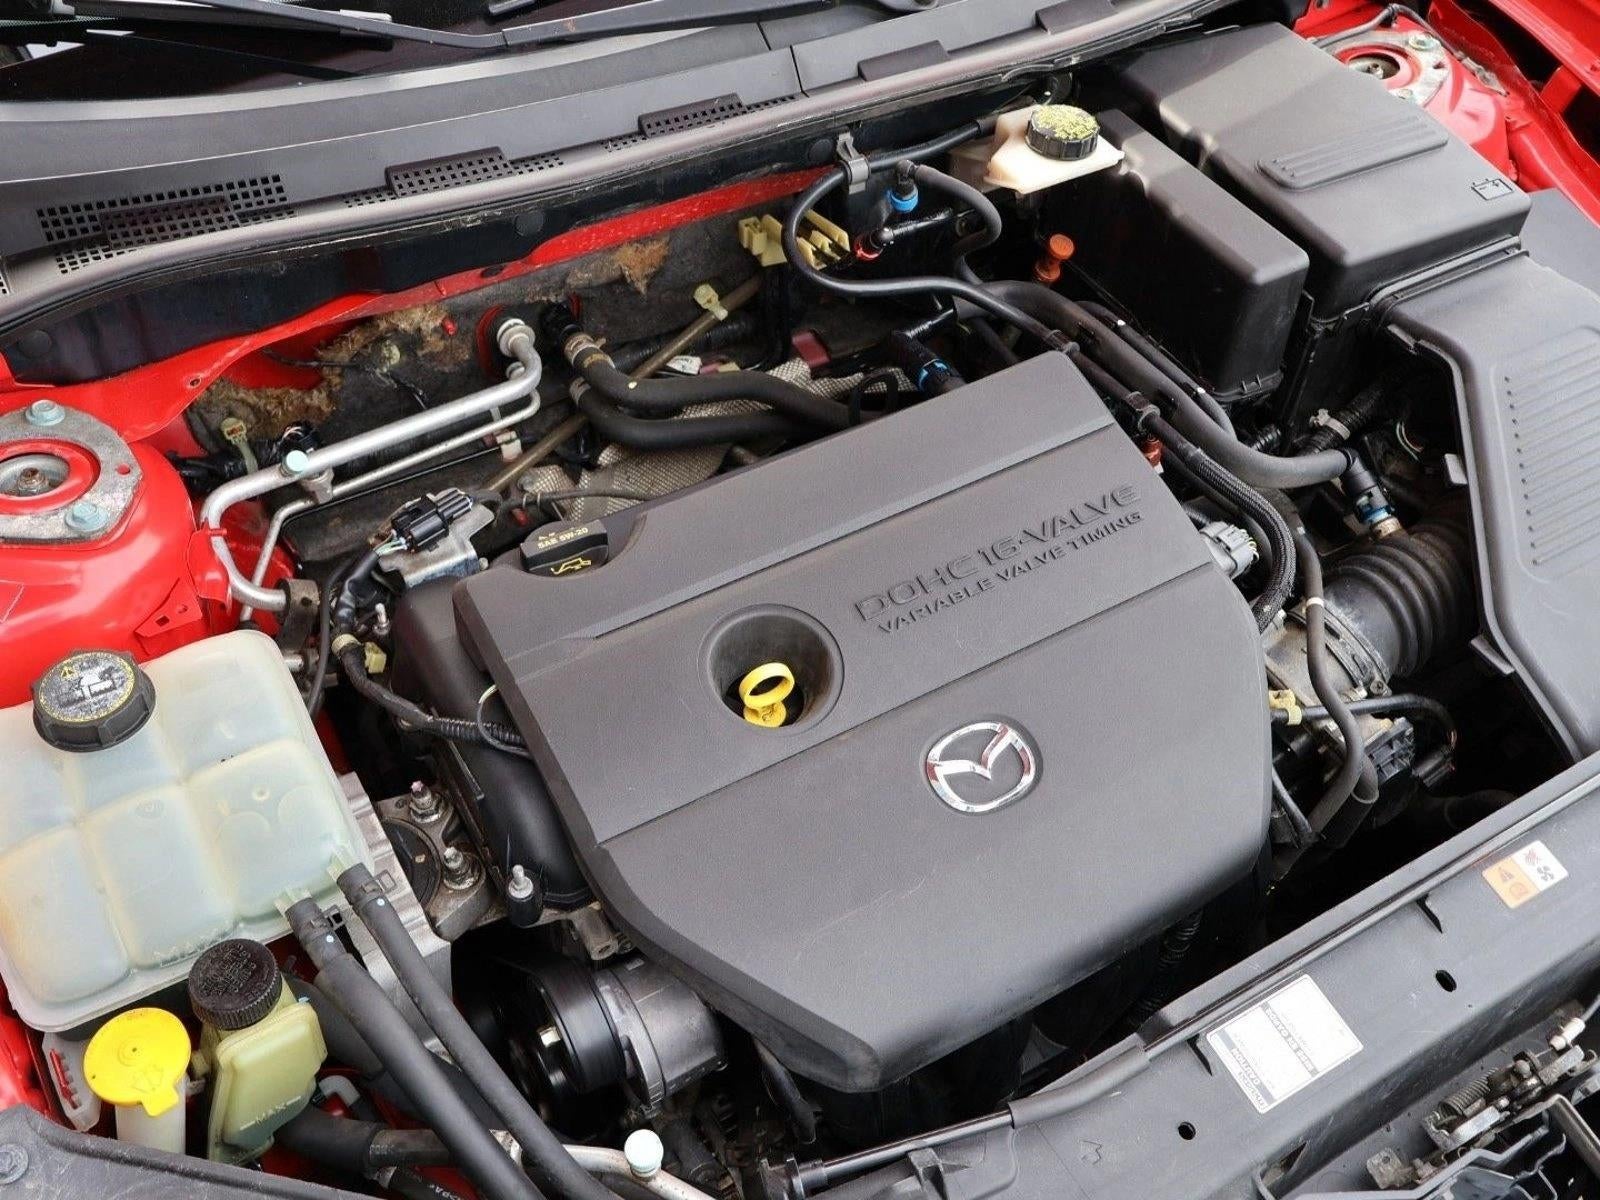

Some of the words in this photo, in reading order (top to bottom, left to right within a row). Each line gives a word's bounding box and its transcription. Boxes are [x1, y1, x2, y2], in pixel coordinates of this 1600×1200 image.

[537, 538, 559, 549] SAE
[559, 527, 589, 542] 5W-20
[854, 561, 981, 621] DOHC
[878, 578, 997, 634] VARIABLE
[995, 545, 1067, 582] VALVE
[1065, 511, 1143, 552] TIMING
